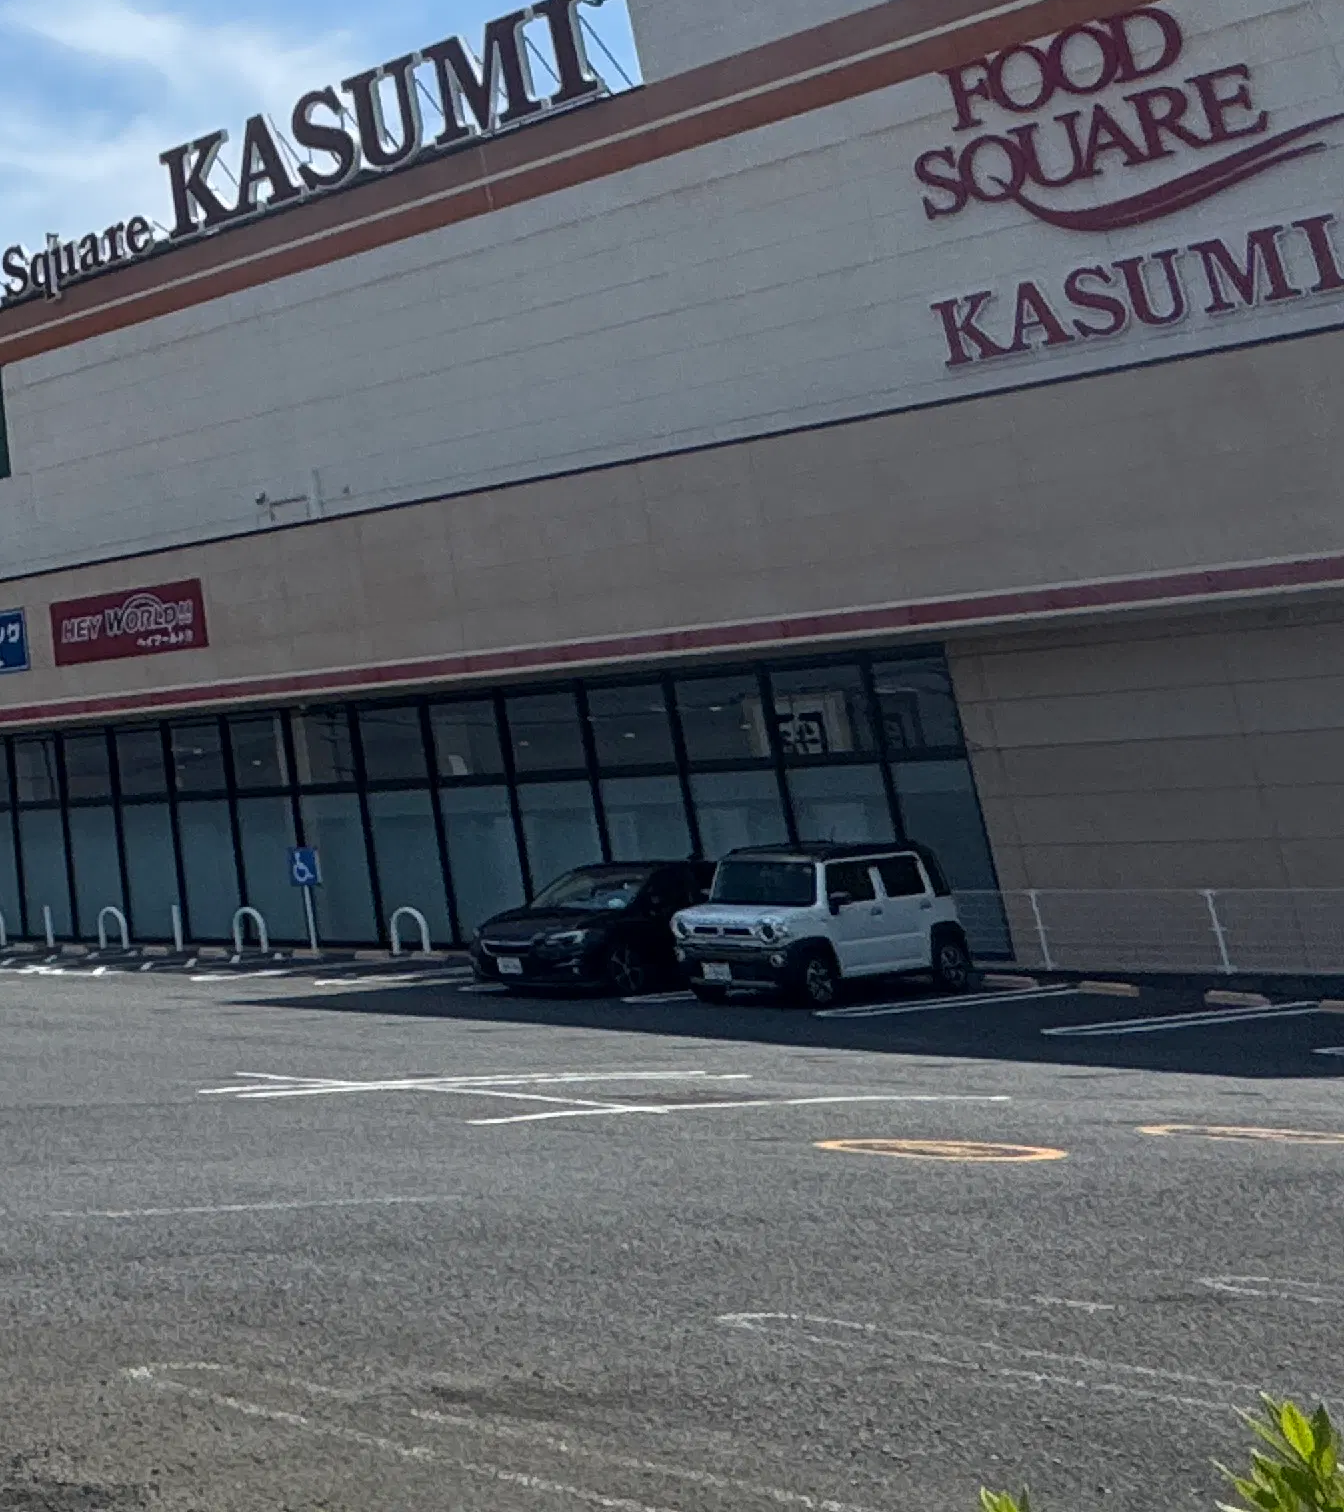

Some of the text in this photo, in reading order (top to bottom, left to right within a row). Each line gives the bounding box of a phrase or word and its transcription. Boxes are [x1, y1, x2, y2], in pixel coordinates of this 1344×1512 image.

[940, 7, 1182, 132] FOOD
[914, 64, 1269, 219] SQUARE
[2, 215, 155, 299] Square
[930, 214, 1344, 367] KASUMI
[62, 615, 103, 644] HEY
